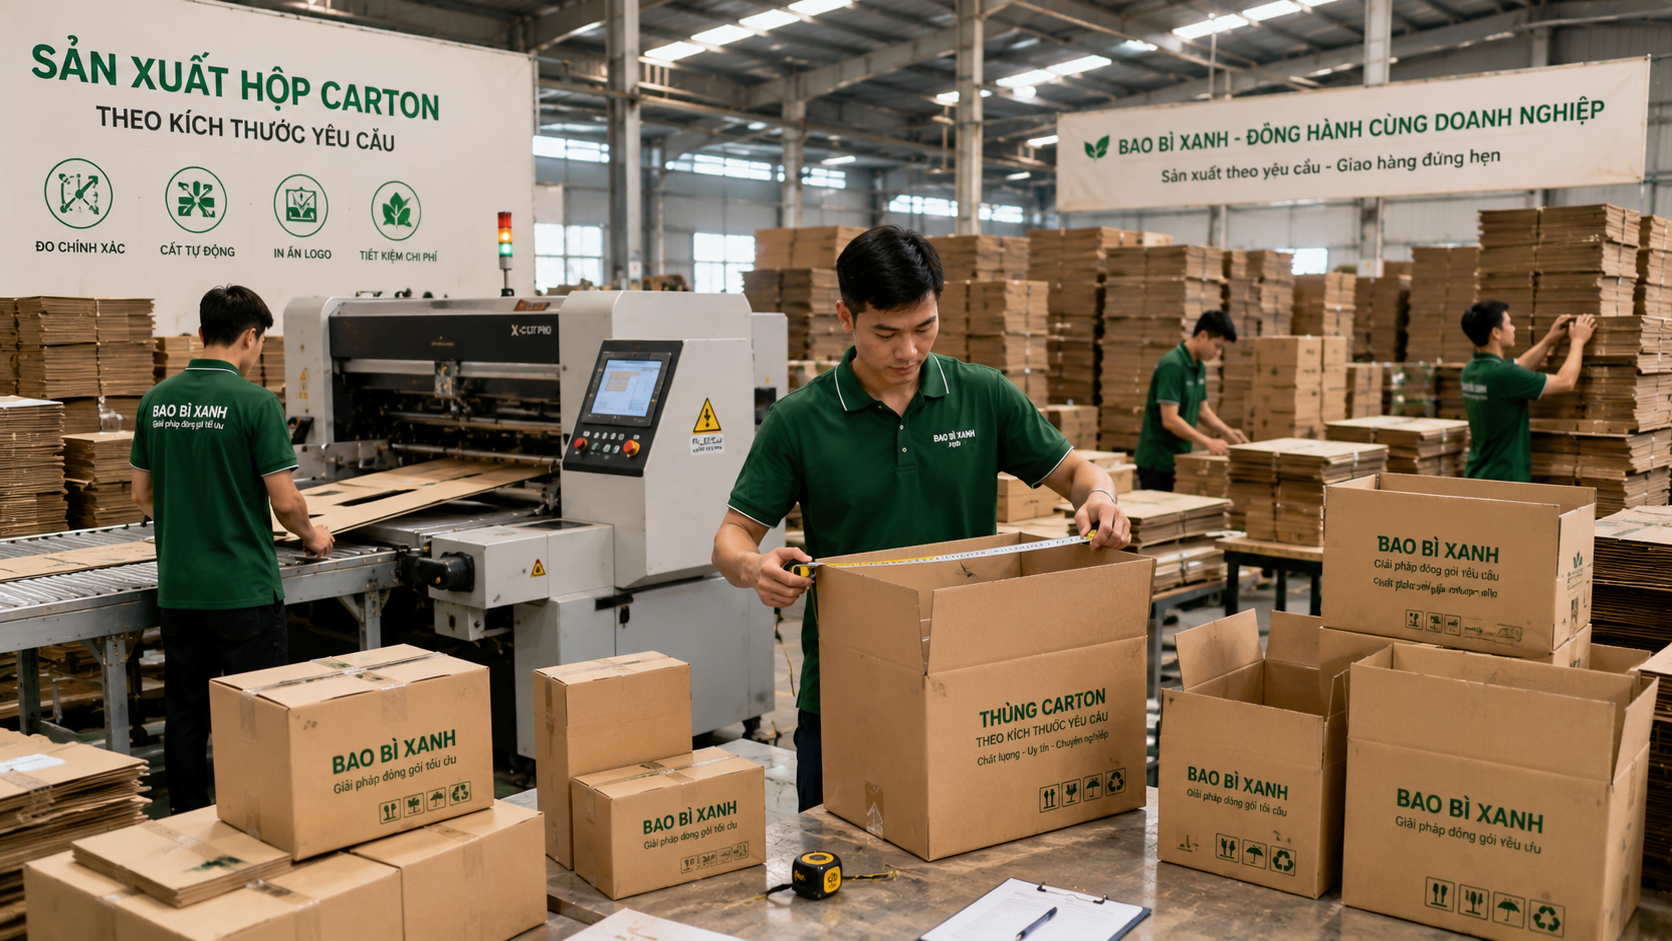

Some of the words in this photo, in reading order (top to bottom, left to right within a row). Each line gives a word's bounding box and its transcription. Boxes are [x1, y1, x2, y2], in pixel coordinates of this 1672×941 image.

[32, 34, 117, 86] SẢN
[130, 52, 229, 97] XUẤT
[241, 66, 310, 112] HỘP
[320, 80, 439, 120] CARTON
[96, 105, 162, 132] THEO
[170, 110, 224, 136] KÍCH
[230, 118, 306, 144] THƯỚC
[312, 124, 350, 148] YÊU
[1118, 136, 1153, 155] BAO
[1158, 131, 1174, 152] BÌ
[1179, 131, 1229, 150] XANH
[1306, 118, 1362, 141] HÀNH
[1369, 113, 1428, 137] CÙNG
[1435, 108, 1512, 132] DOANH
[1520, 96, 1605, 125] NGHIỆP
[1226, 165, 1258, 178] theo
[1337, 158, 1372, 172] Giao
[1377, 154, 1417, 171] hàng
[1470, 149, 1501, 167] hẹn
[35, 241, 55, 252] ĐO
[58, 239, 97, 253] CHÍNH
[274, 248, 284, 258] IN
[305, 249, 332, 259] LOGO
[406, 252, 420, 261] CHI
[423, 250, 438, 262] PHÍ
[152, 404, 176, 417] BAO
[179, 402, 192, 418] BÌ
[193, 405, 228, 419] XANH
[933, 434, 948, 442] BAO
[1377, 535, 1416, 555] BAO
[1422, 536, 1439, 558] BÌ
[1444, 542, 1499, 564] XANH
[979, 702, 1037, 728] THÙNG
[1042, 688, 1106, 714] CARTON
[332, 748, 374, 775] BAO
[380, 738, 398, 763] BÌ
[404, 729, 456, 758] XANH
[976, 733, 1004, 747] THEO
[1028, 746, 1038, 757] Uy
[1187, 766, 1220, 786] BAO
[1224, 770, 1239, 790] BÌ
[1243, 777, 1288, 801] XANH
[643, 814, 674, 835] BAO
[679, 807, 692, 827] BÌ
[696, 800, 737, 823] XANH
[1397, 788, 1442, 814] BAO
[1449, 795, 1470, 820] BÌ
[1477, 803, 1544, 834] XANH
